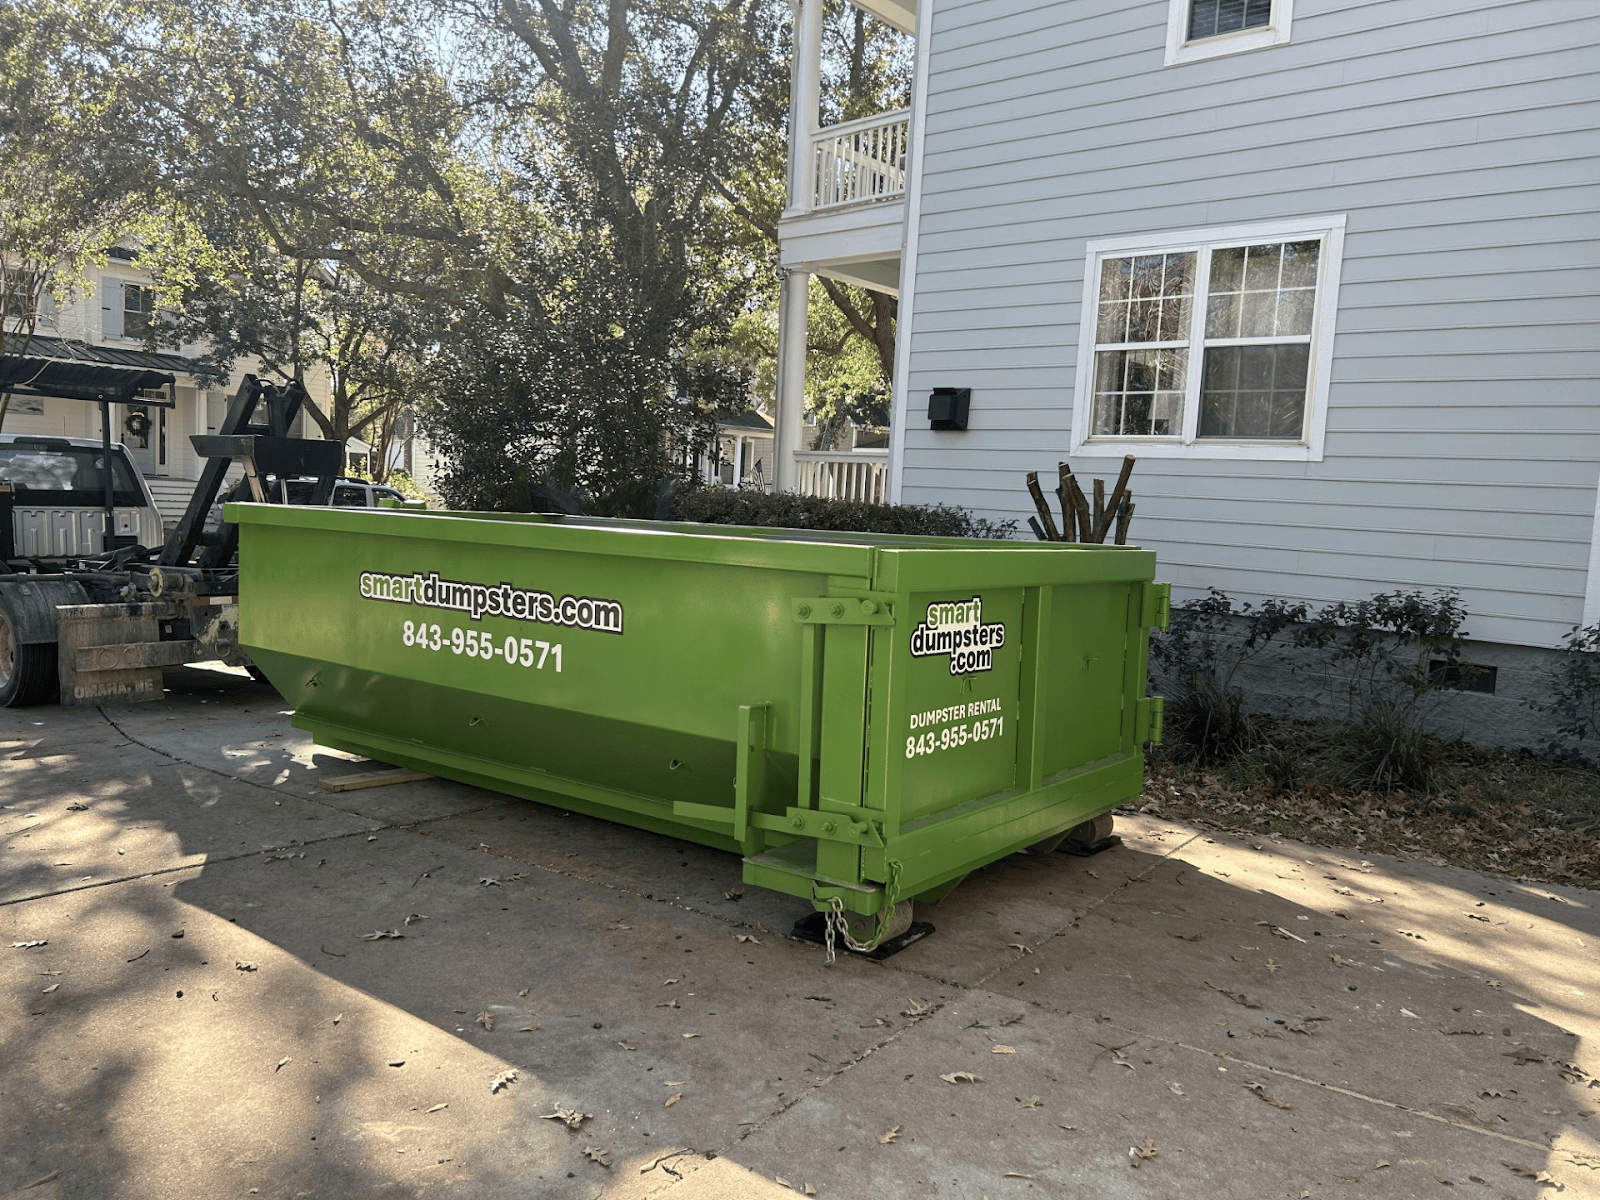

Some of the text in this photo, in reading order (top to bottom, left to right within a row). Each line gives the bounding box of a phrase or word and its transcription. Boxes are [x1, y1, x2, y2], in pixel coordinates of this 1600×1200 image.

[360, 571, 623, 634] smartdumpsters.com
[928, 598, 981, 628] smart
[402, 620, 563, 672] 843-955-0571
[912, 625, 1005, 655] dumpsters
[951, 648, 992, 674] .com
[910, 697, 1002, 729] DUMPSTER RENTAL
[905, 716, 1004, 759] 843-955-0571
